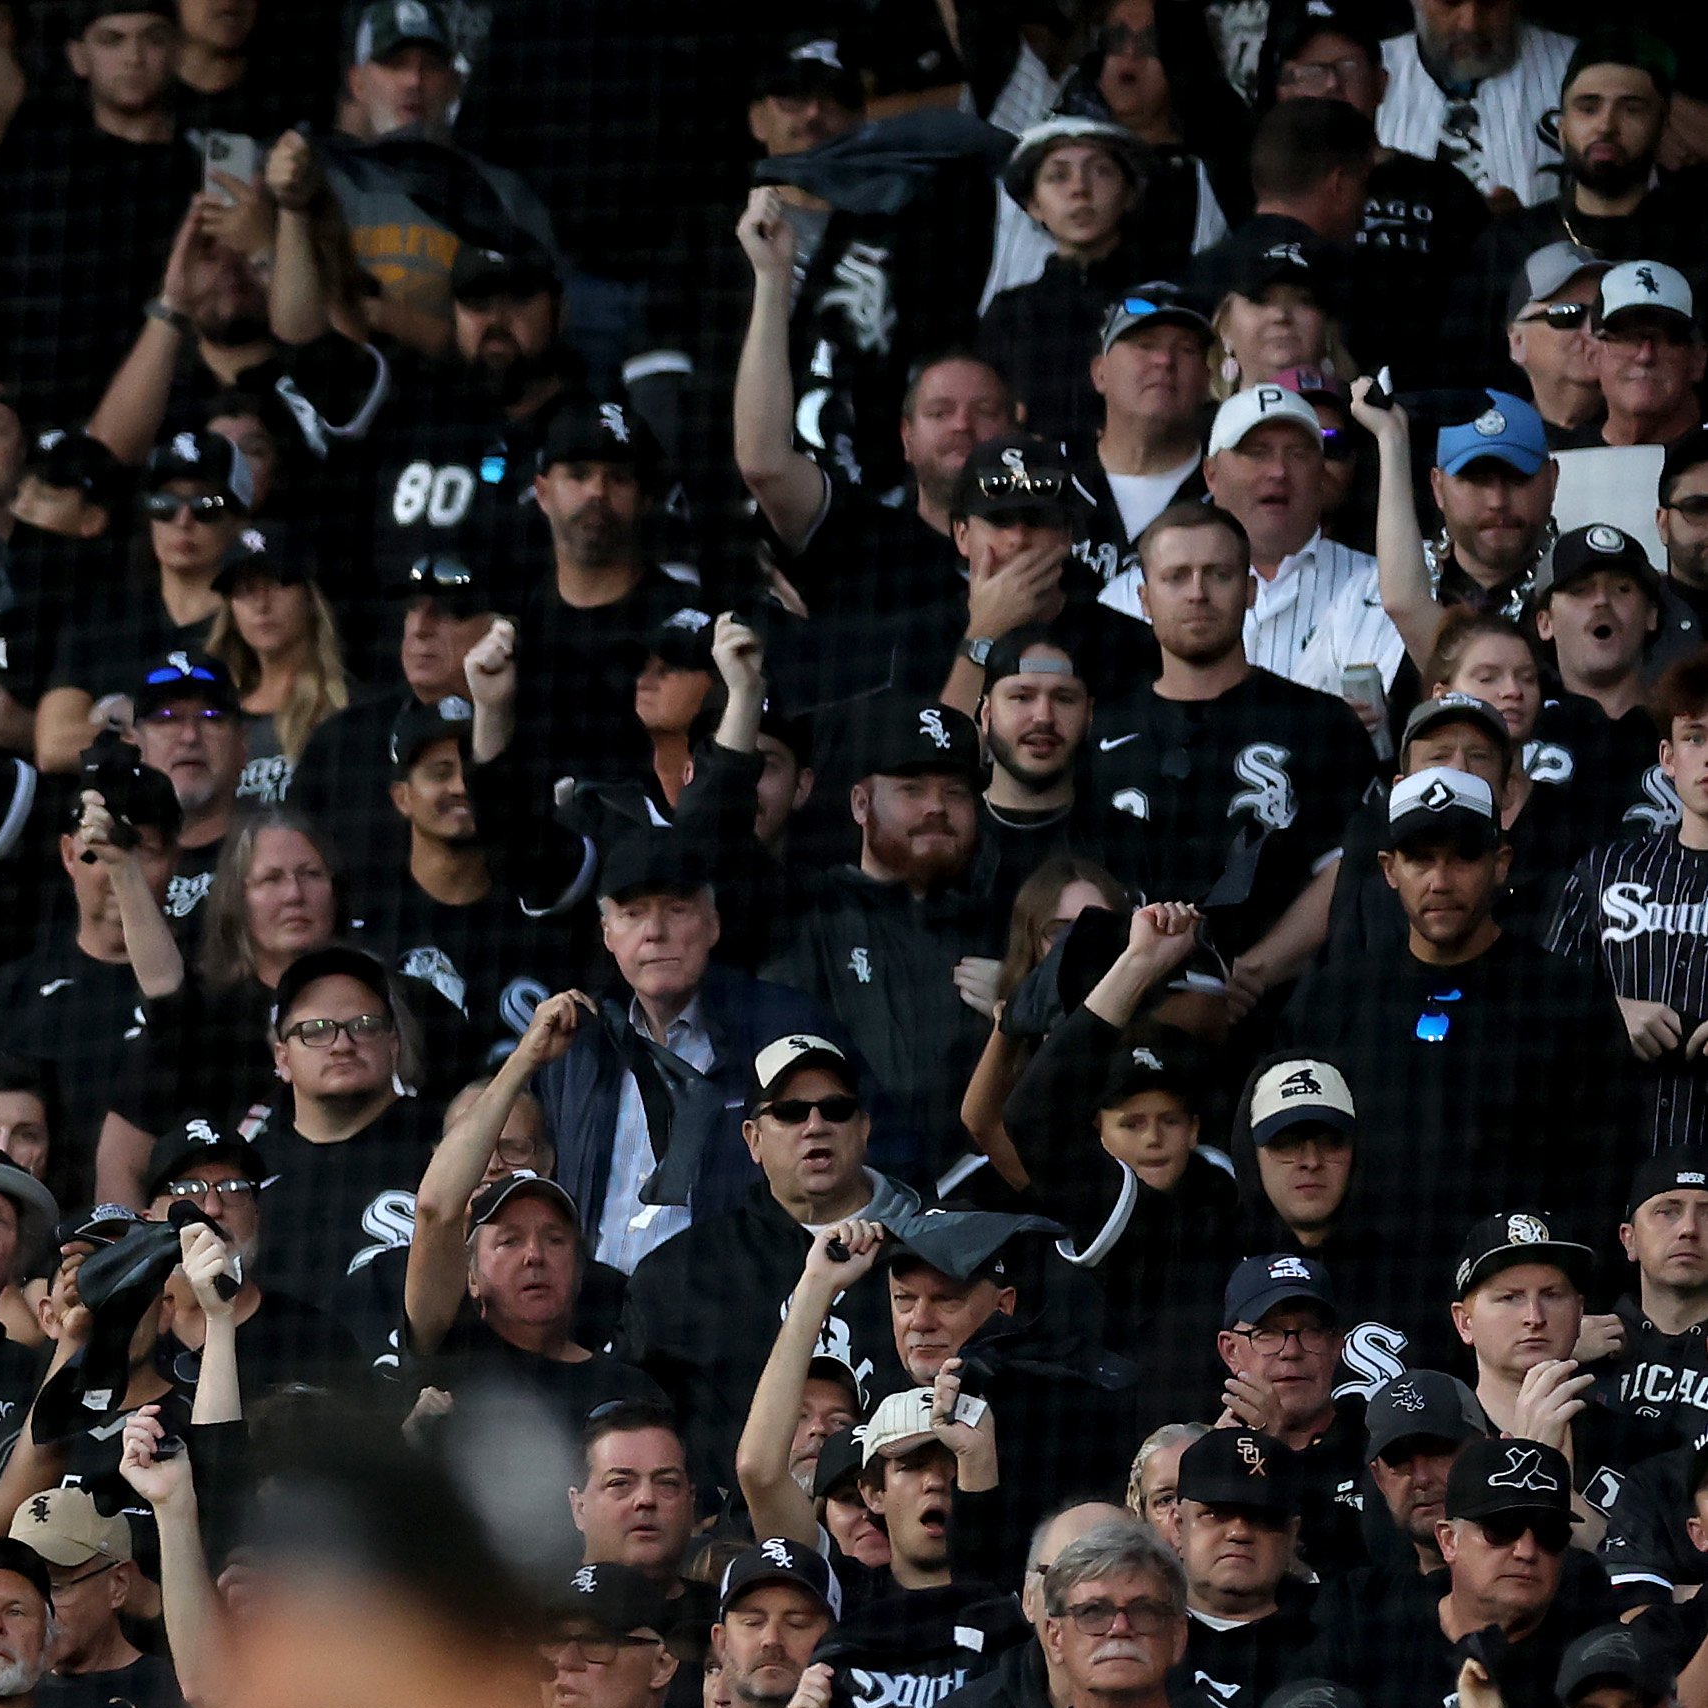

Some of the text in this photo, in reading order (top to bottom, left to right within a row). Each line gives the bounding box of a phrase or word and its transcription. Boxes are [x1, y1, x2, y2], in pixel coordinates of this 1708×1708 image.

[1259, 389, 1283, 412] P
[392, 460, 474, 525] 80
[919, 709, 951, 750] Sox
[1235, 1437, 1267, 1476] SOX
[761, 1538, 794, 1570] Sox
